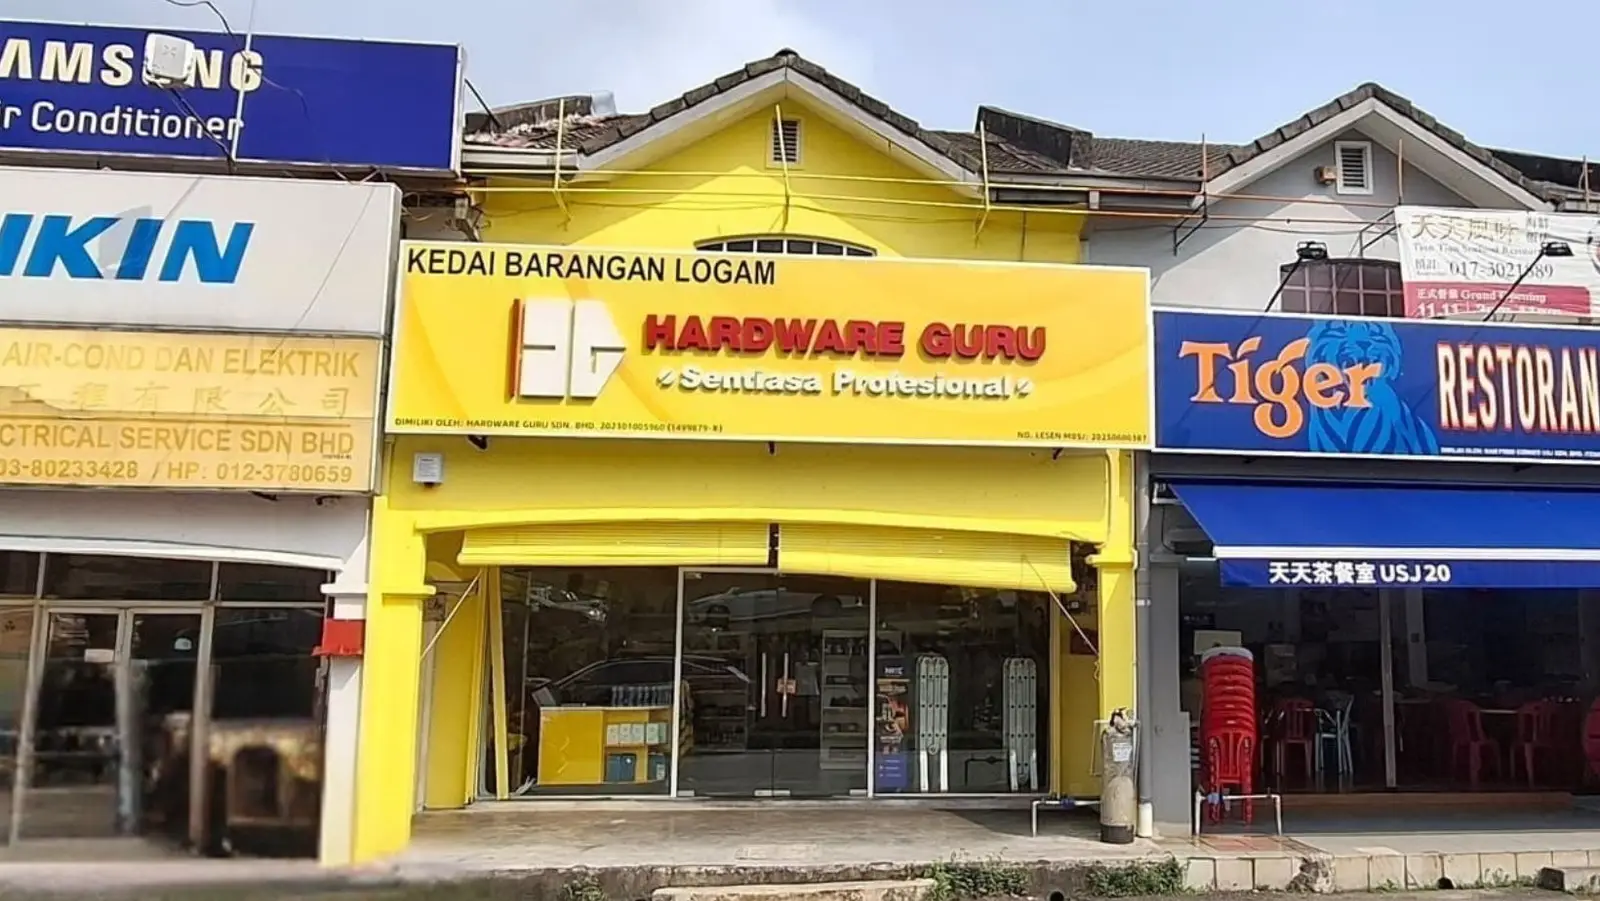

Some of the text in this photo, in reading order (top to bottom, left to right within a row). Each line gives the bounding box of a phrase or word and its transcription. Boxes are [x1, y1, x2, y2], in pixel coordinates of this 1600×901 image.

[0, 38, 263, 92] AMSNG
[32, 101, 244, 140] Conditioner
[408, 249, 775, 285] KEDAI BARANGAN LOGAM
[1460, 289, 1497, 301] Grand
[645, 314, 1046, 361] HARDWARE GURU
[2, 341, 359, 378] AIR-COND DAN ELEKTRIK
[681, 366, 1010, 399] Sentiasa Profesional
[1178, 336, 1383, 438] Tiger
[1437, 341, 1600, 434] RESTORAN
[119, 426, 232, 451] SERVICE
[240, 430, 292, 453] SDN
[302, 432, 354, 454] BHD
[466, 420, 519, 428] HARDWARE
[523, 420, 549, 429] GURU
[216, 462, 353, 483] 012-3780659
[1269, 562, 1376, 584] 天天茶餐室
